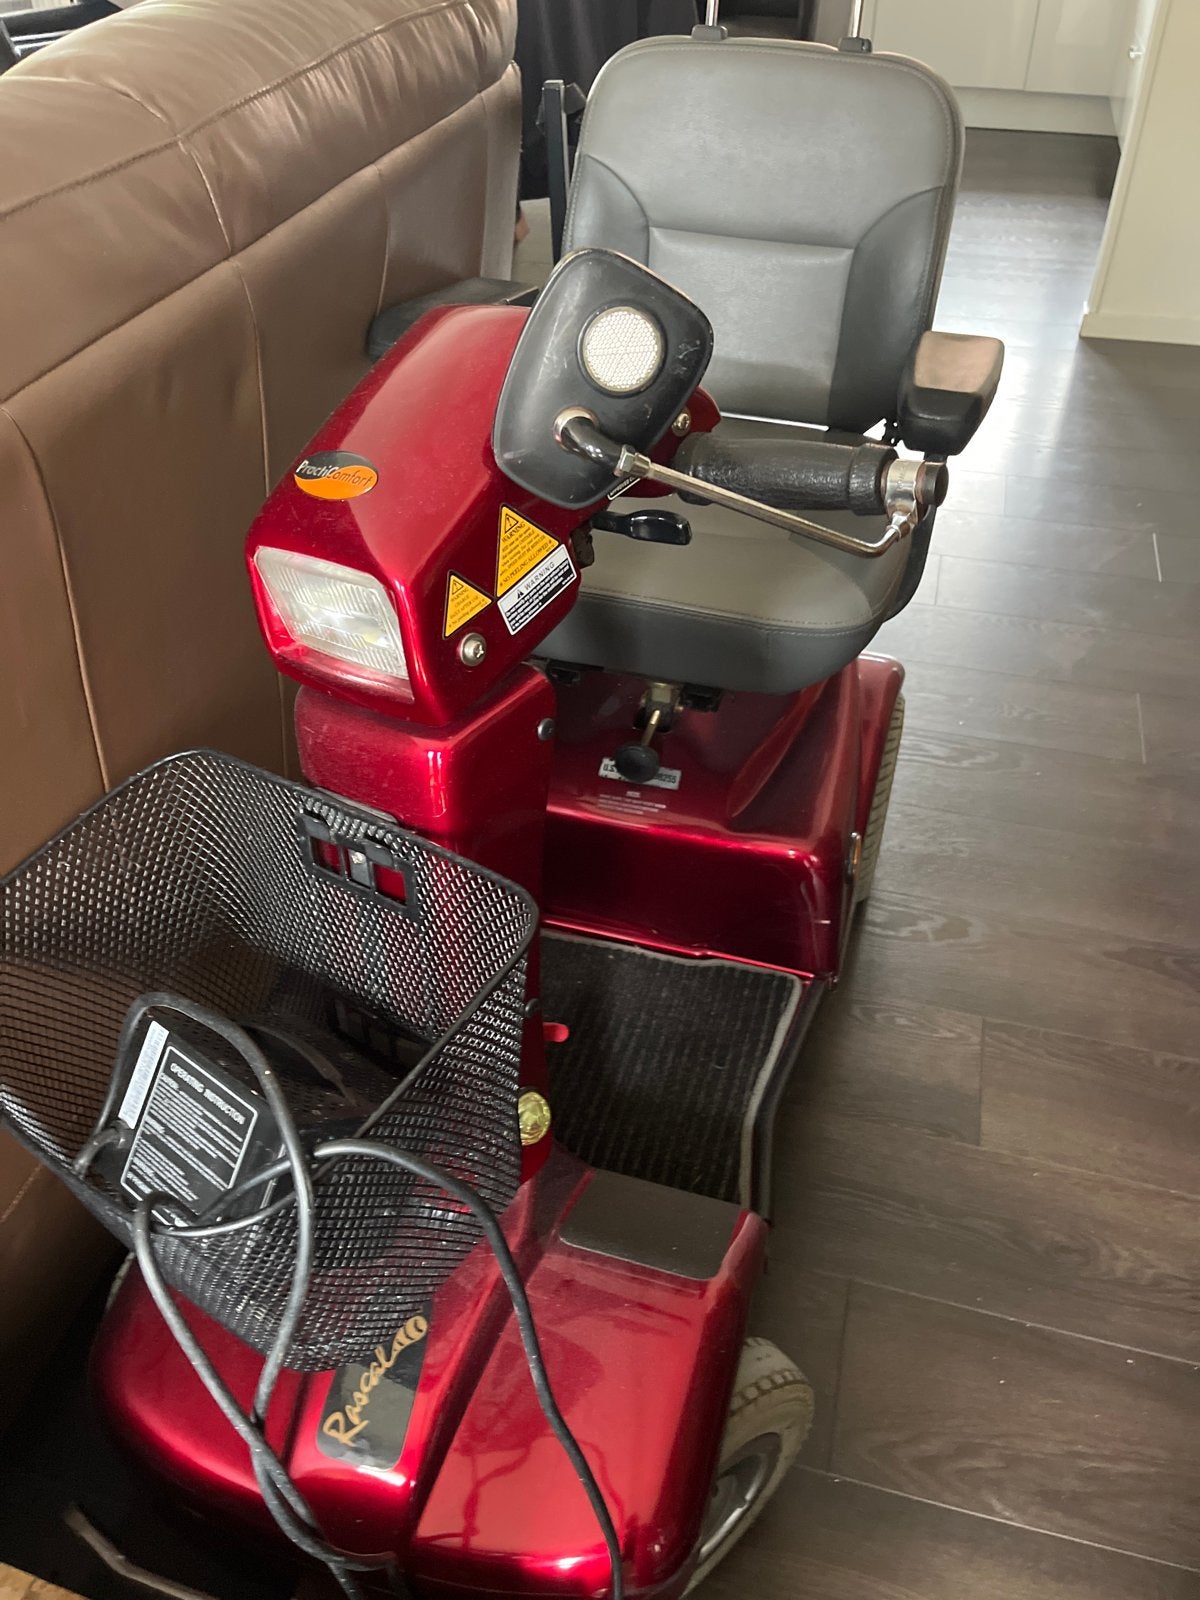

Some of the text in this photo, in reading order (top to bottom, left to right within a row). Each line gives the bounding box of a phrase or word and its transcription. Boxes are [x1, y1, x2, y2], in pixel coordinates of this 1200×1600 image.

[295, 460, 373, 487] PractiComfort
[501, 521, 525, 543] WARNING
[524, 561, 555, 590] WARNING
